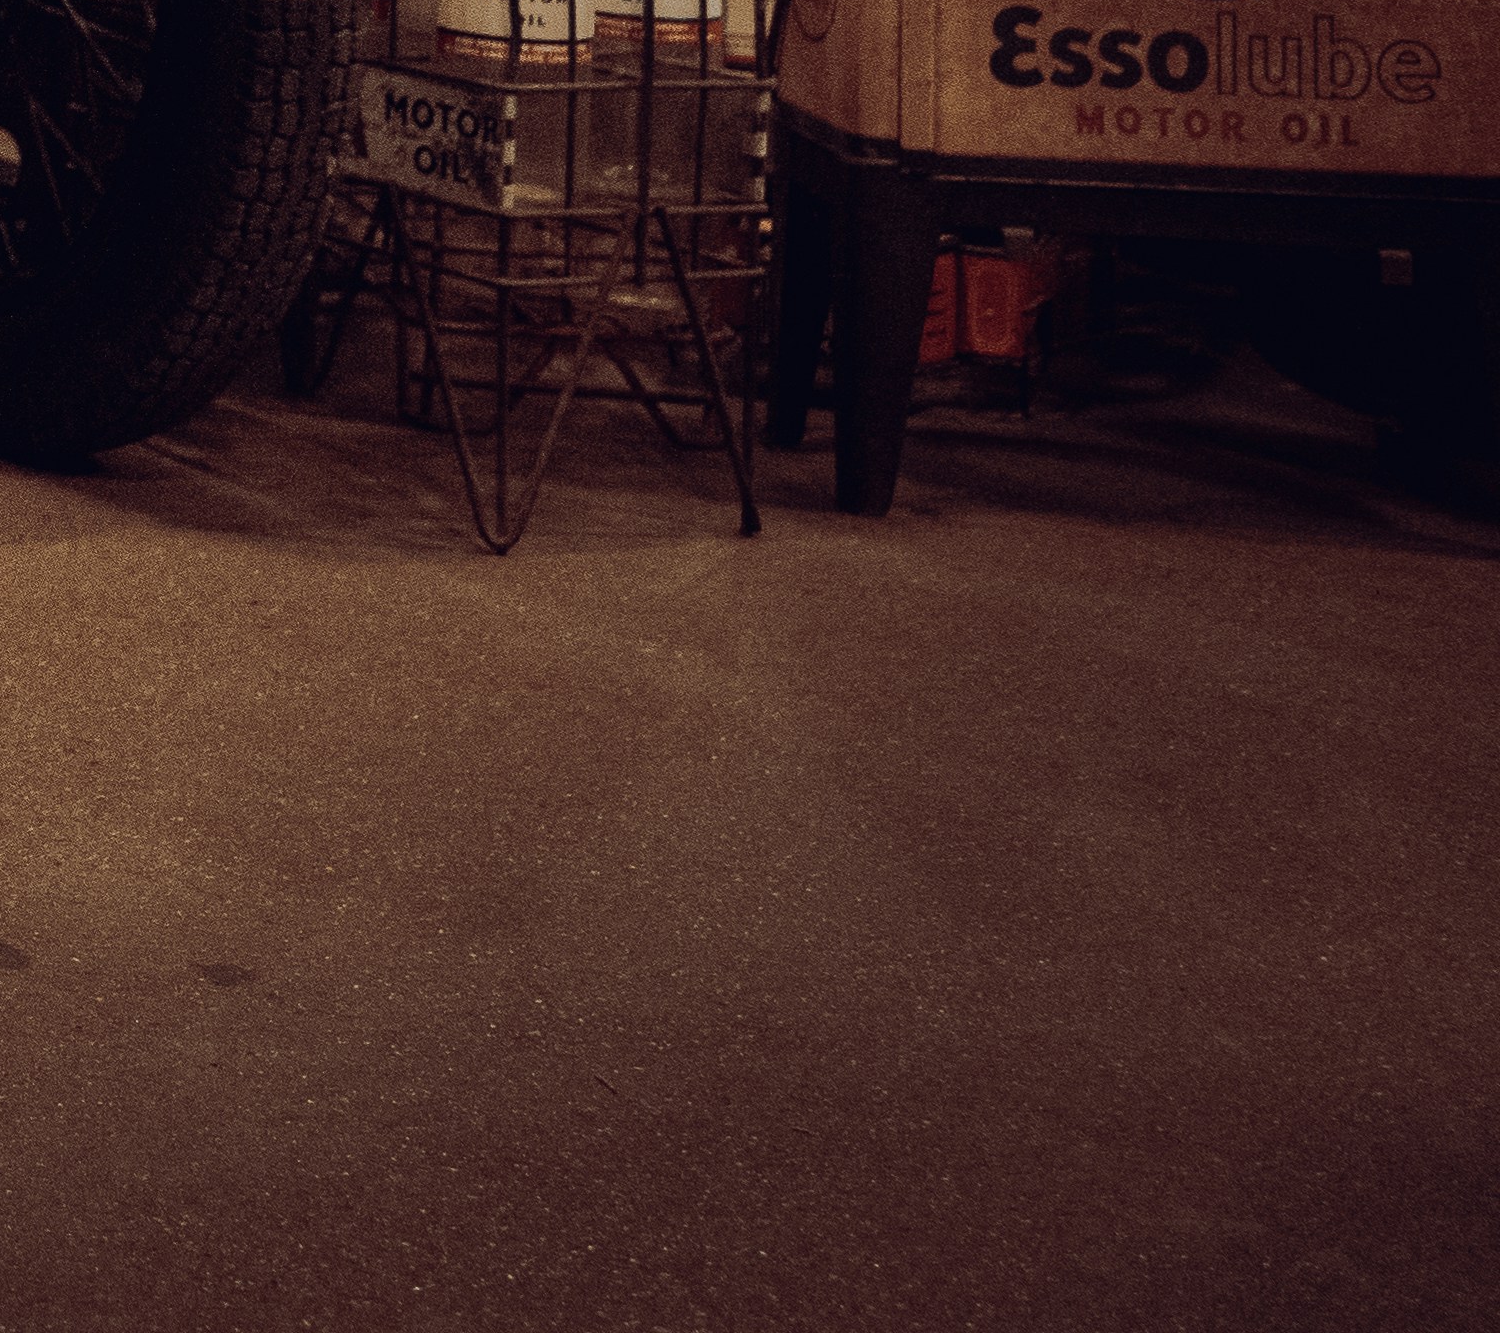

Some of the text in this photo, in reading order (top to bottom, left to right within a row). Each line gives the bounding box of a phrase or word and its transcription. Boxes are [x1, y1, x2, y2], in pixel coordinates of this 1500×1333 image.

[988, 6, 1443, 104] Essolube
[385, 92, 499, 145] MOTOR
[1074, 105, 1362, 148] MOTOR OIL
[413, 144, 470, 184] OIL
